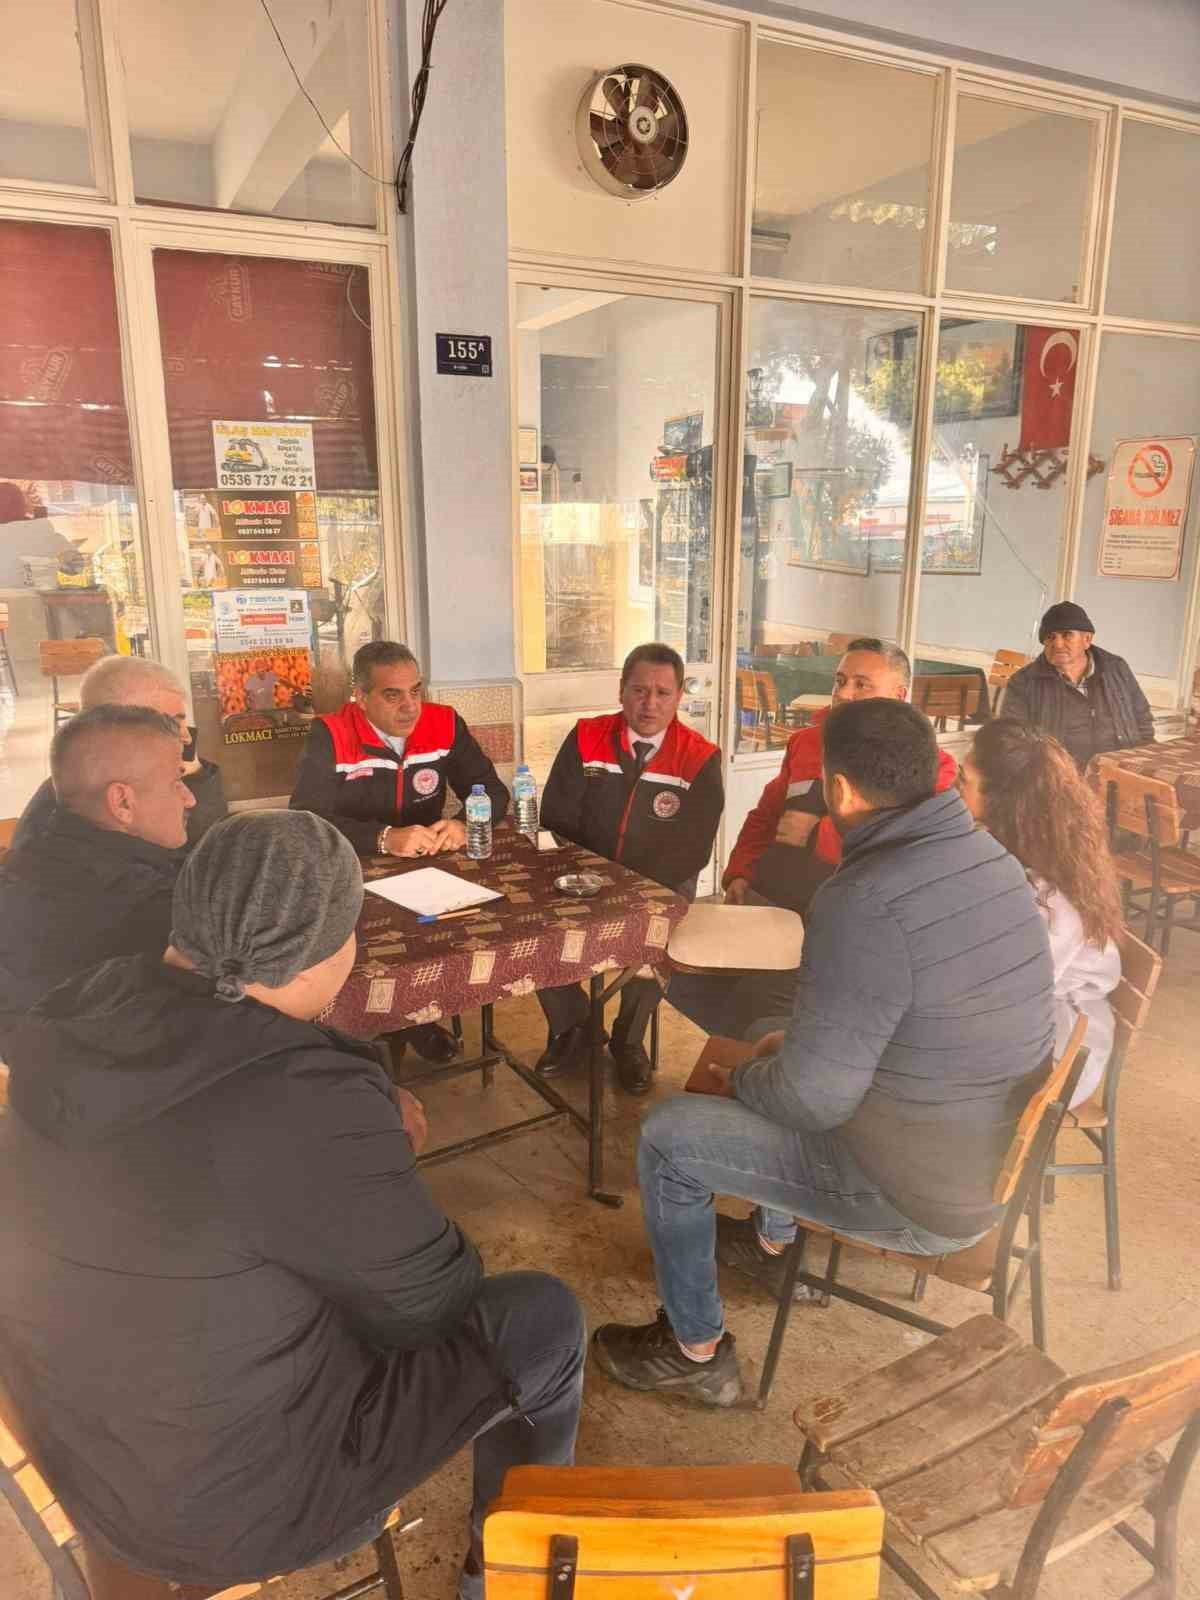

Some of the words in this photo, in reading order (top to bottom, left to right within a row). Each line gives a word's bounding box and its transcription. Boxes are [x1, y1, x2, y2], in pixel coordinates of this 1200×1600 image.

[220, 475, 251, 486] 0536
[254, 475, 277, 486] 737
[281, 475, 297, 487] 42
[300, 475, 313, 487] 21
[225, 729, 272, 745] LOKMACI
